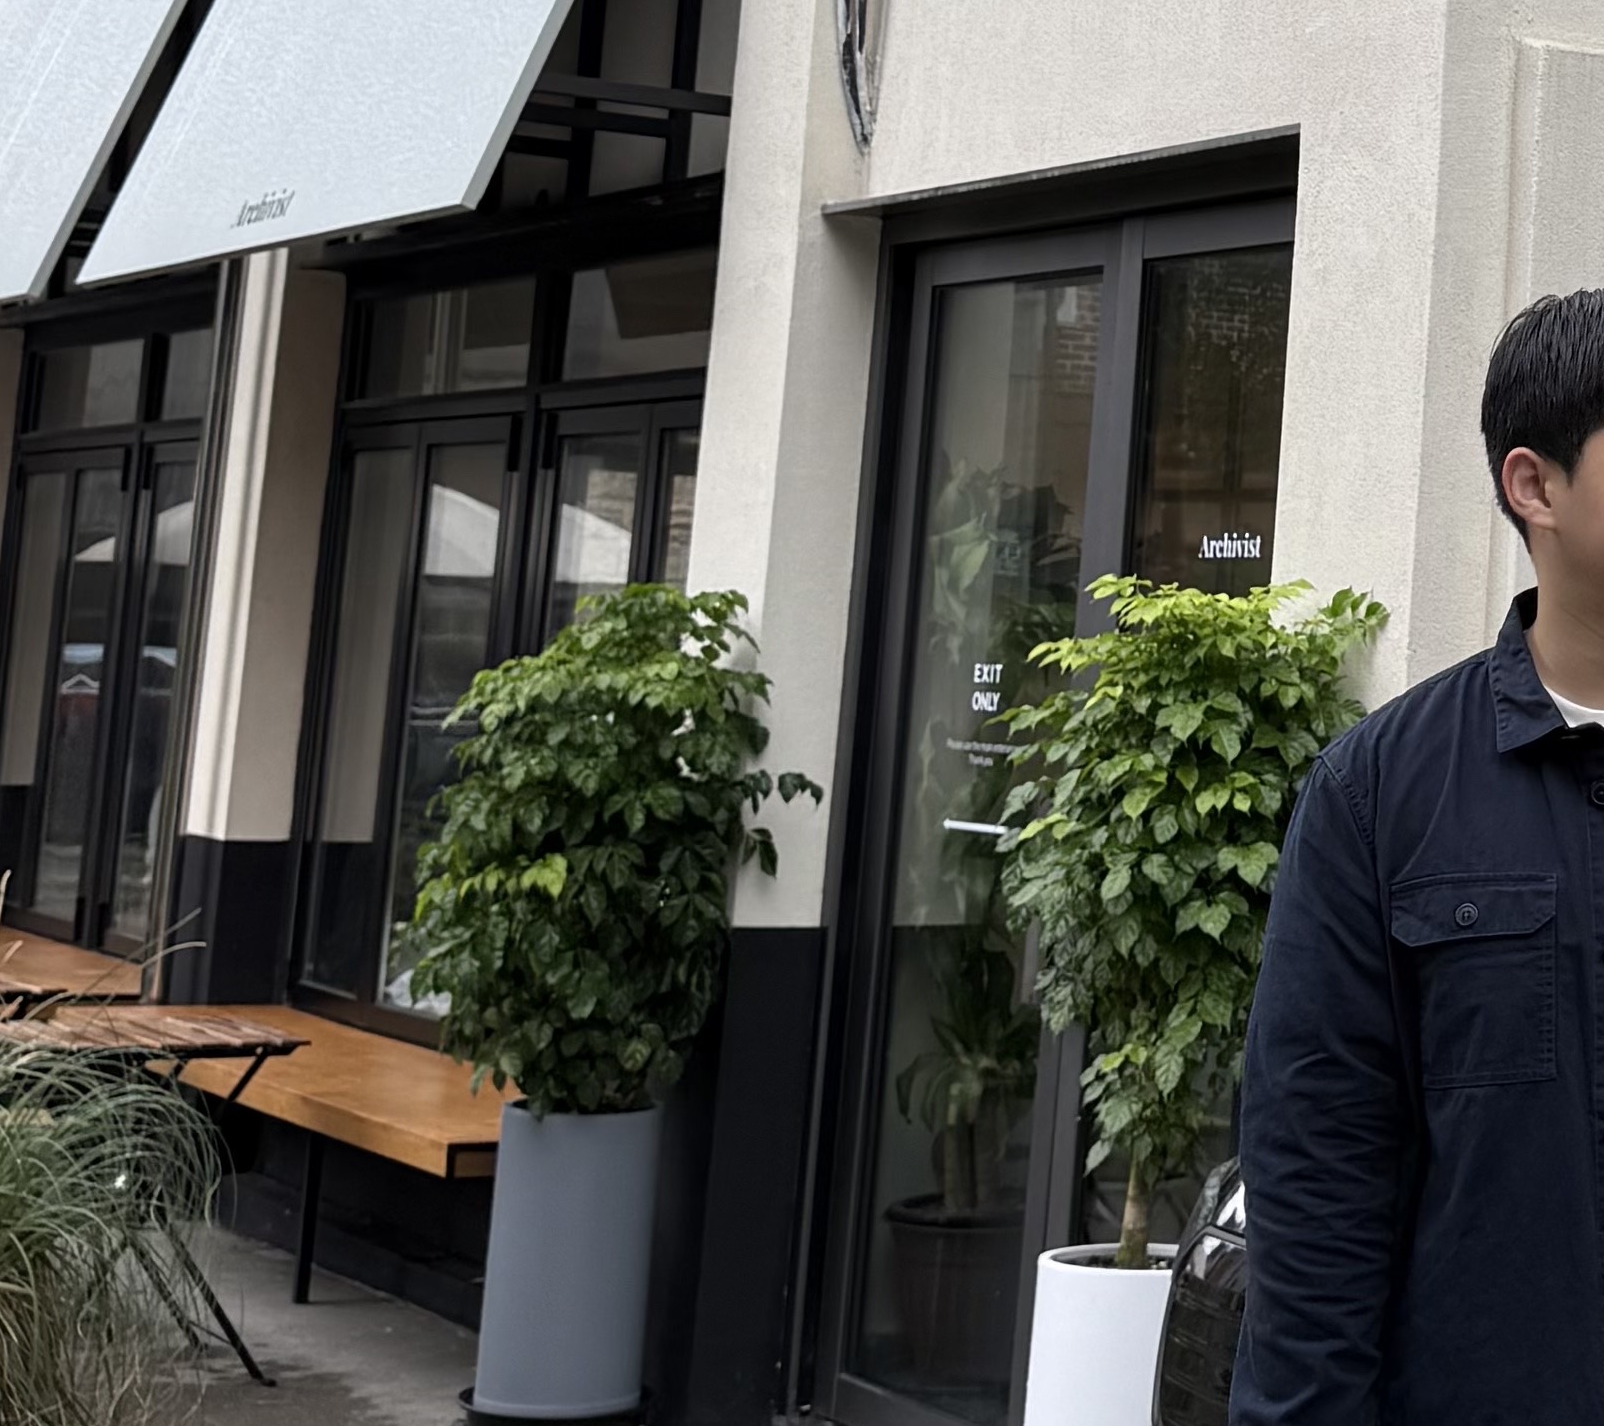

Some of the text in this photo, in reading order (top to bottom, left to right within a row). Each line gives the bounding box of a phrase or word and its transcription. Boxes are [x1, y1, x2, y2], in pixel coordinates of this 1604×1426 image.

[230, 188, 296, 229] Archivist
[1198, 533, 1262, 560] Archivist
[973, 663, 1004, 684] EXIT
[971, 691, 1001, 711] ONLY
